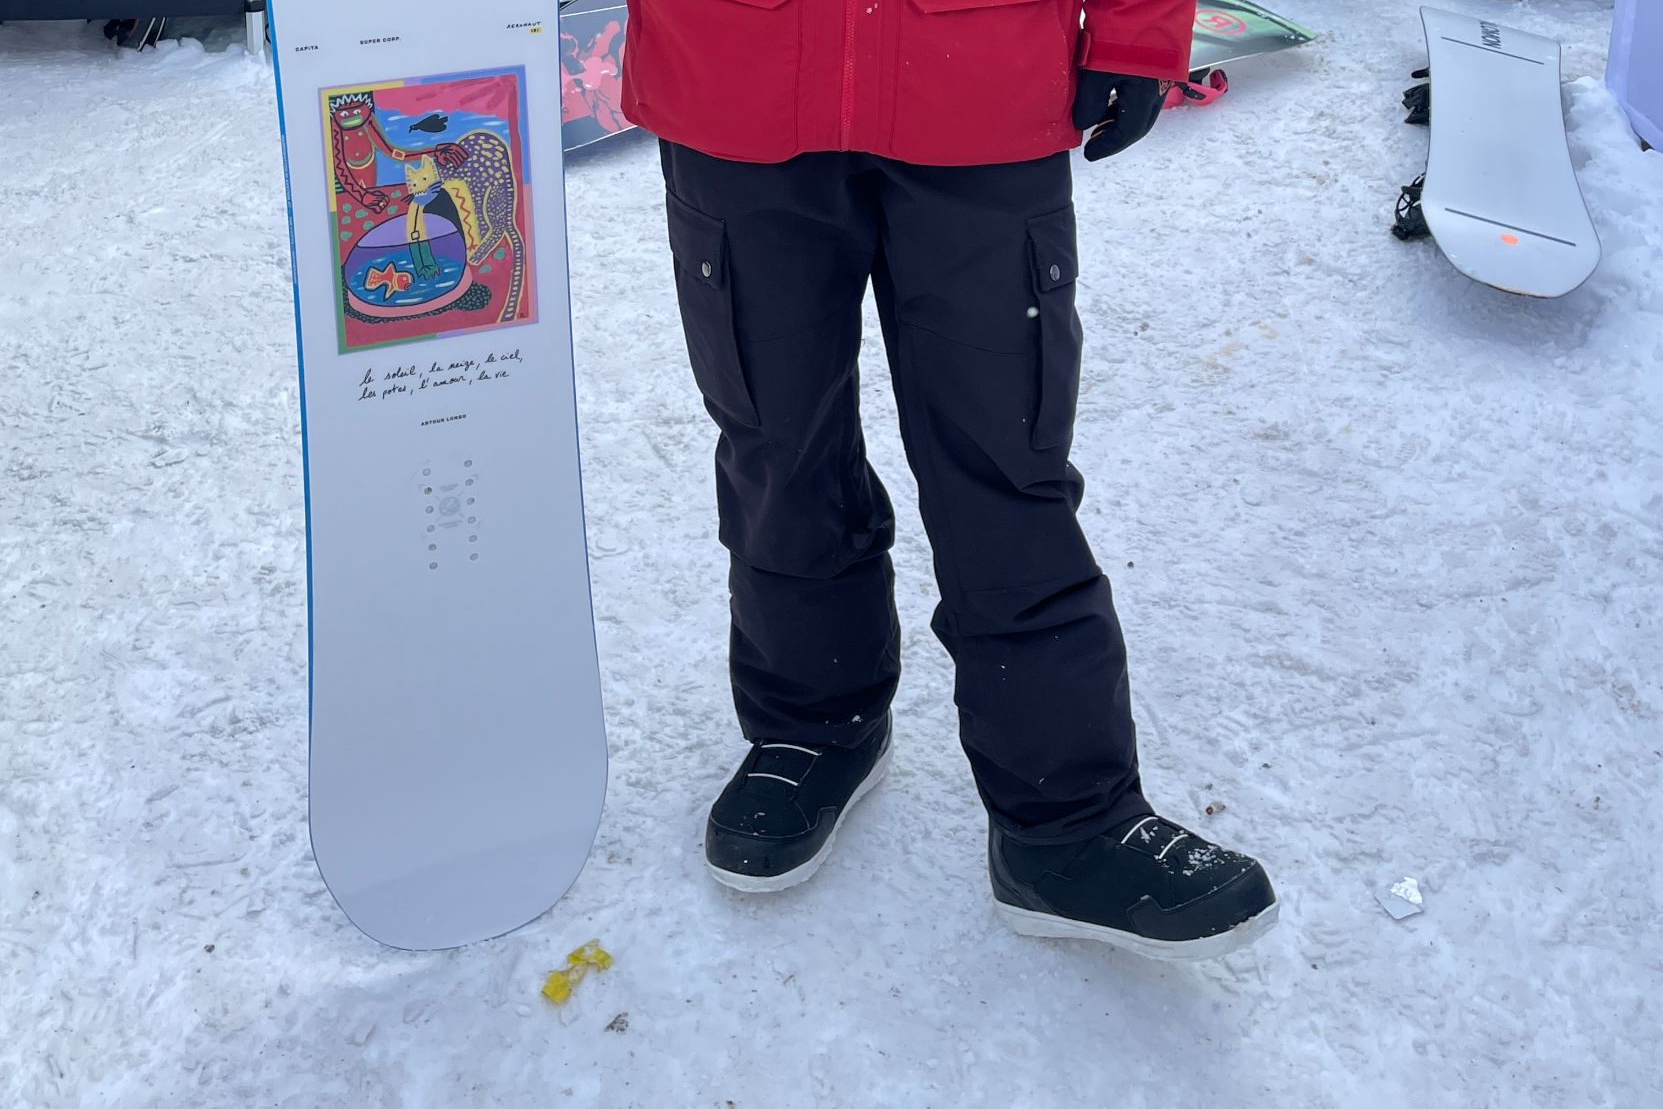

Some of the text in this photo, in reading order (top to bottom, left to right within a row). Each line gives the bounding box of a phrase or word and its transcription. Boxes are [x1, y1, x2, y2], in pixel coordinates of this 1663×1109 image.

[358, 387, 376, 401] les
[478, 371, 491, 380] la
[495, 371, 509, 379] vie
[359, 368, 374, 387] le
[429, 362, 443, 373] la
[485, 353, 497, 363] le
